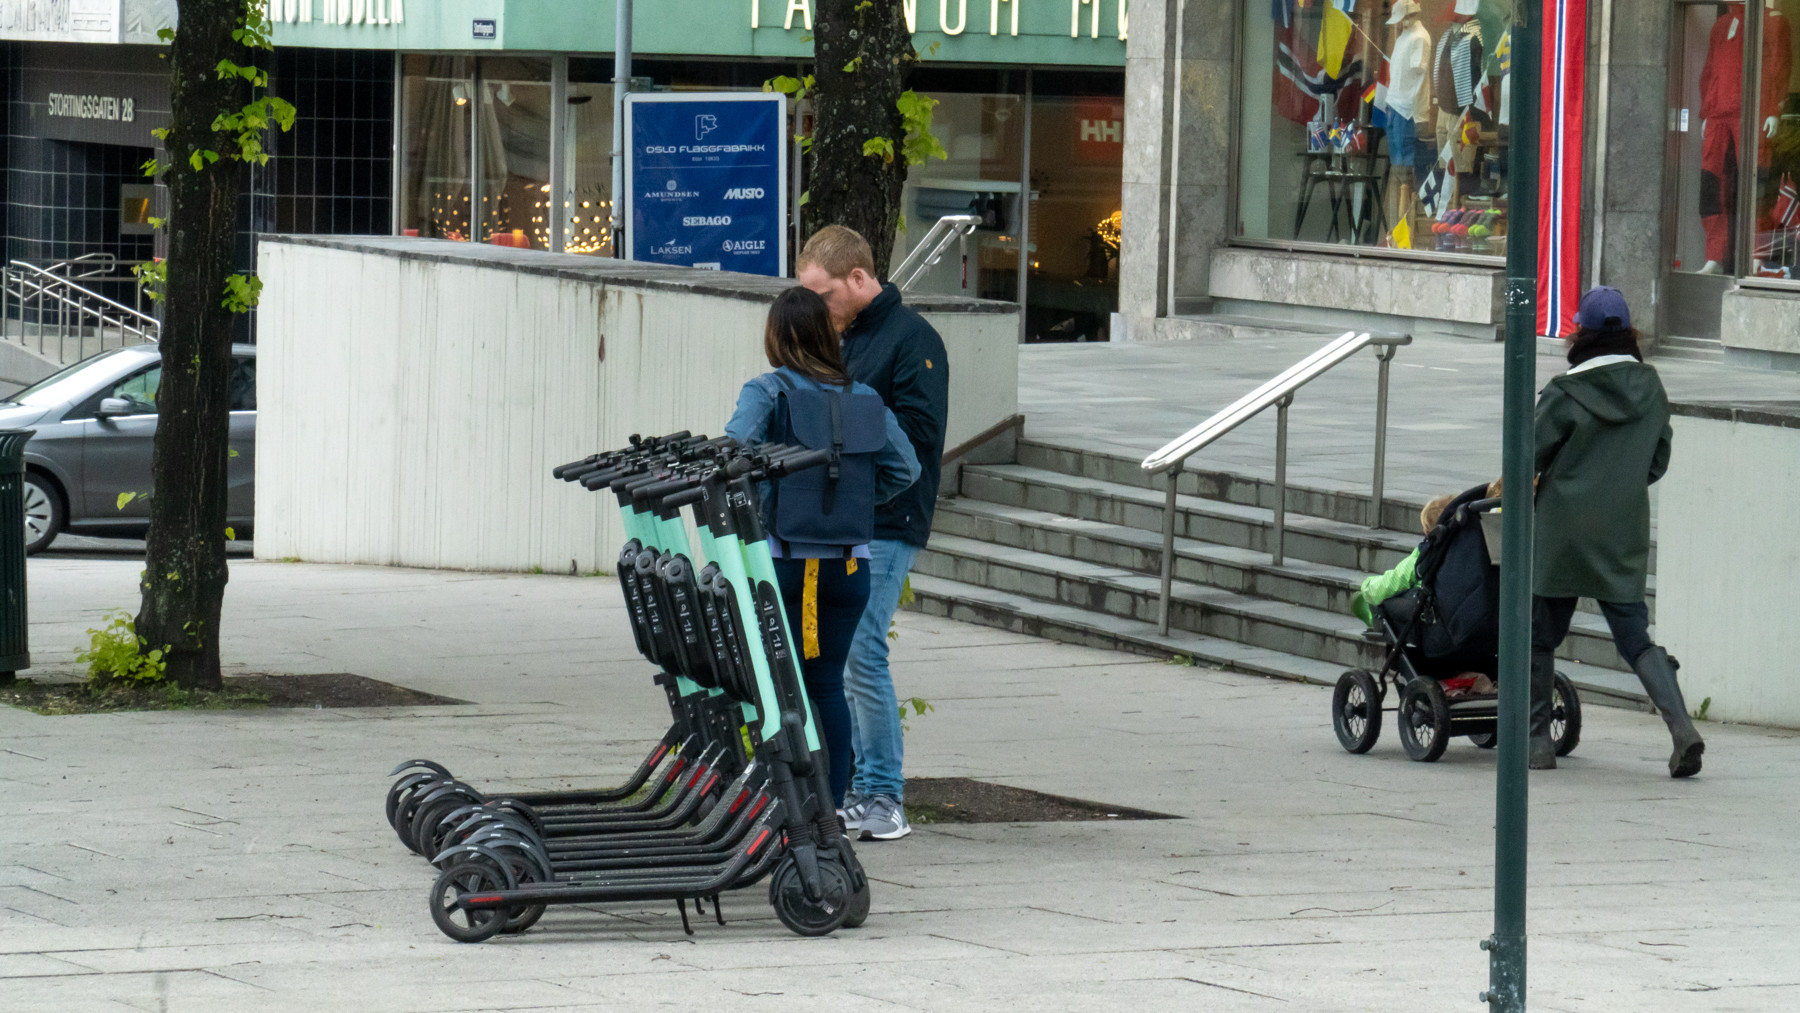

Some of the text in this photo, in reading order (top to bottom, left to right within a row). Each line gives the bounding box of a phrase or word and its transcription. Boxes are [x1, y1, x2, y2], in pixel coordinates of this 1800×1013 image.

[48, 92, 134, 122] STORTINGSGATEN 28
[1081, 119, 1121, 143] HH
[646, 145, 677, 154] OSLO
[644, 191, 700, 199] AMUNDSEN
[723, 187, 765, 200] MUSTO
[682, 215, 732, 227] SEBAGO
[650, 245, 692, 255] LAKSEN
[733, 240, 766, 250] AIGLE
